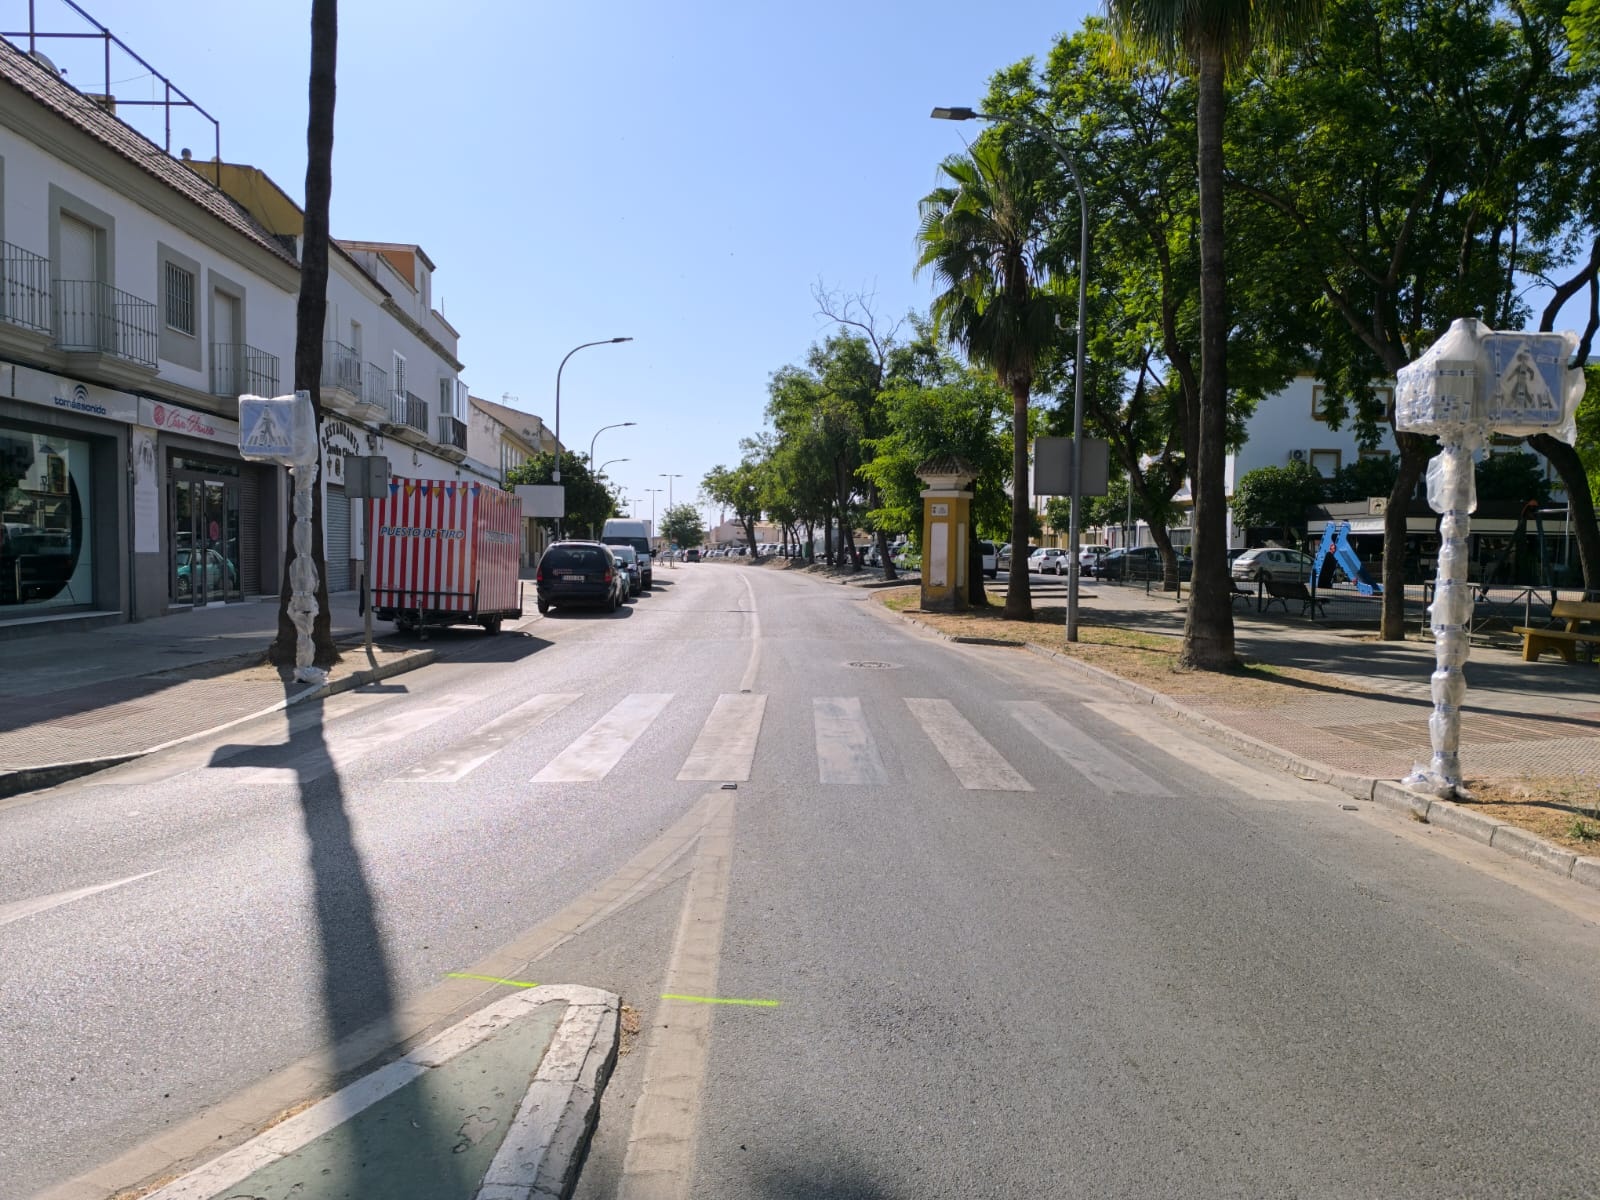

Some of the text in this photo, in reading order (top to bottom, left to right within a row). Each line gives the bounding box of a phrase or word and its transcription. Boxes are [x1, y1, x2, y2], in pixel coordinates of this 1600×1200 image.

[321, 422, 359, 455] RESTAURANTE
[380, 526, 464, 539] PUESTO DE TIRO
